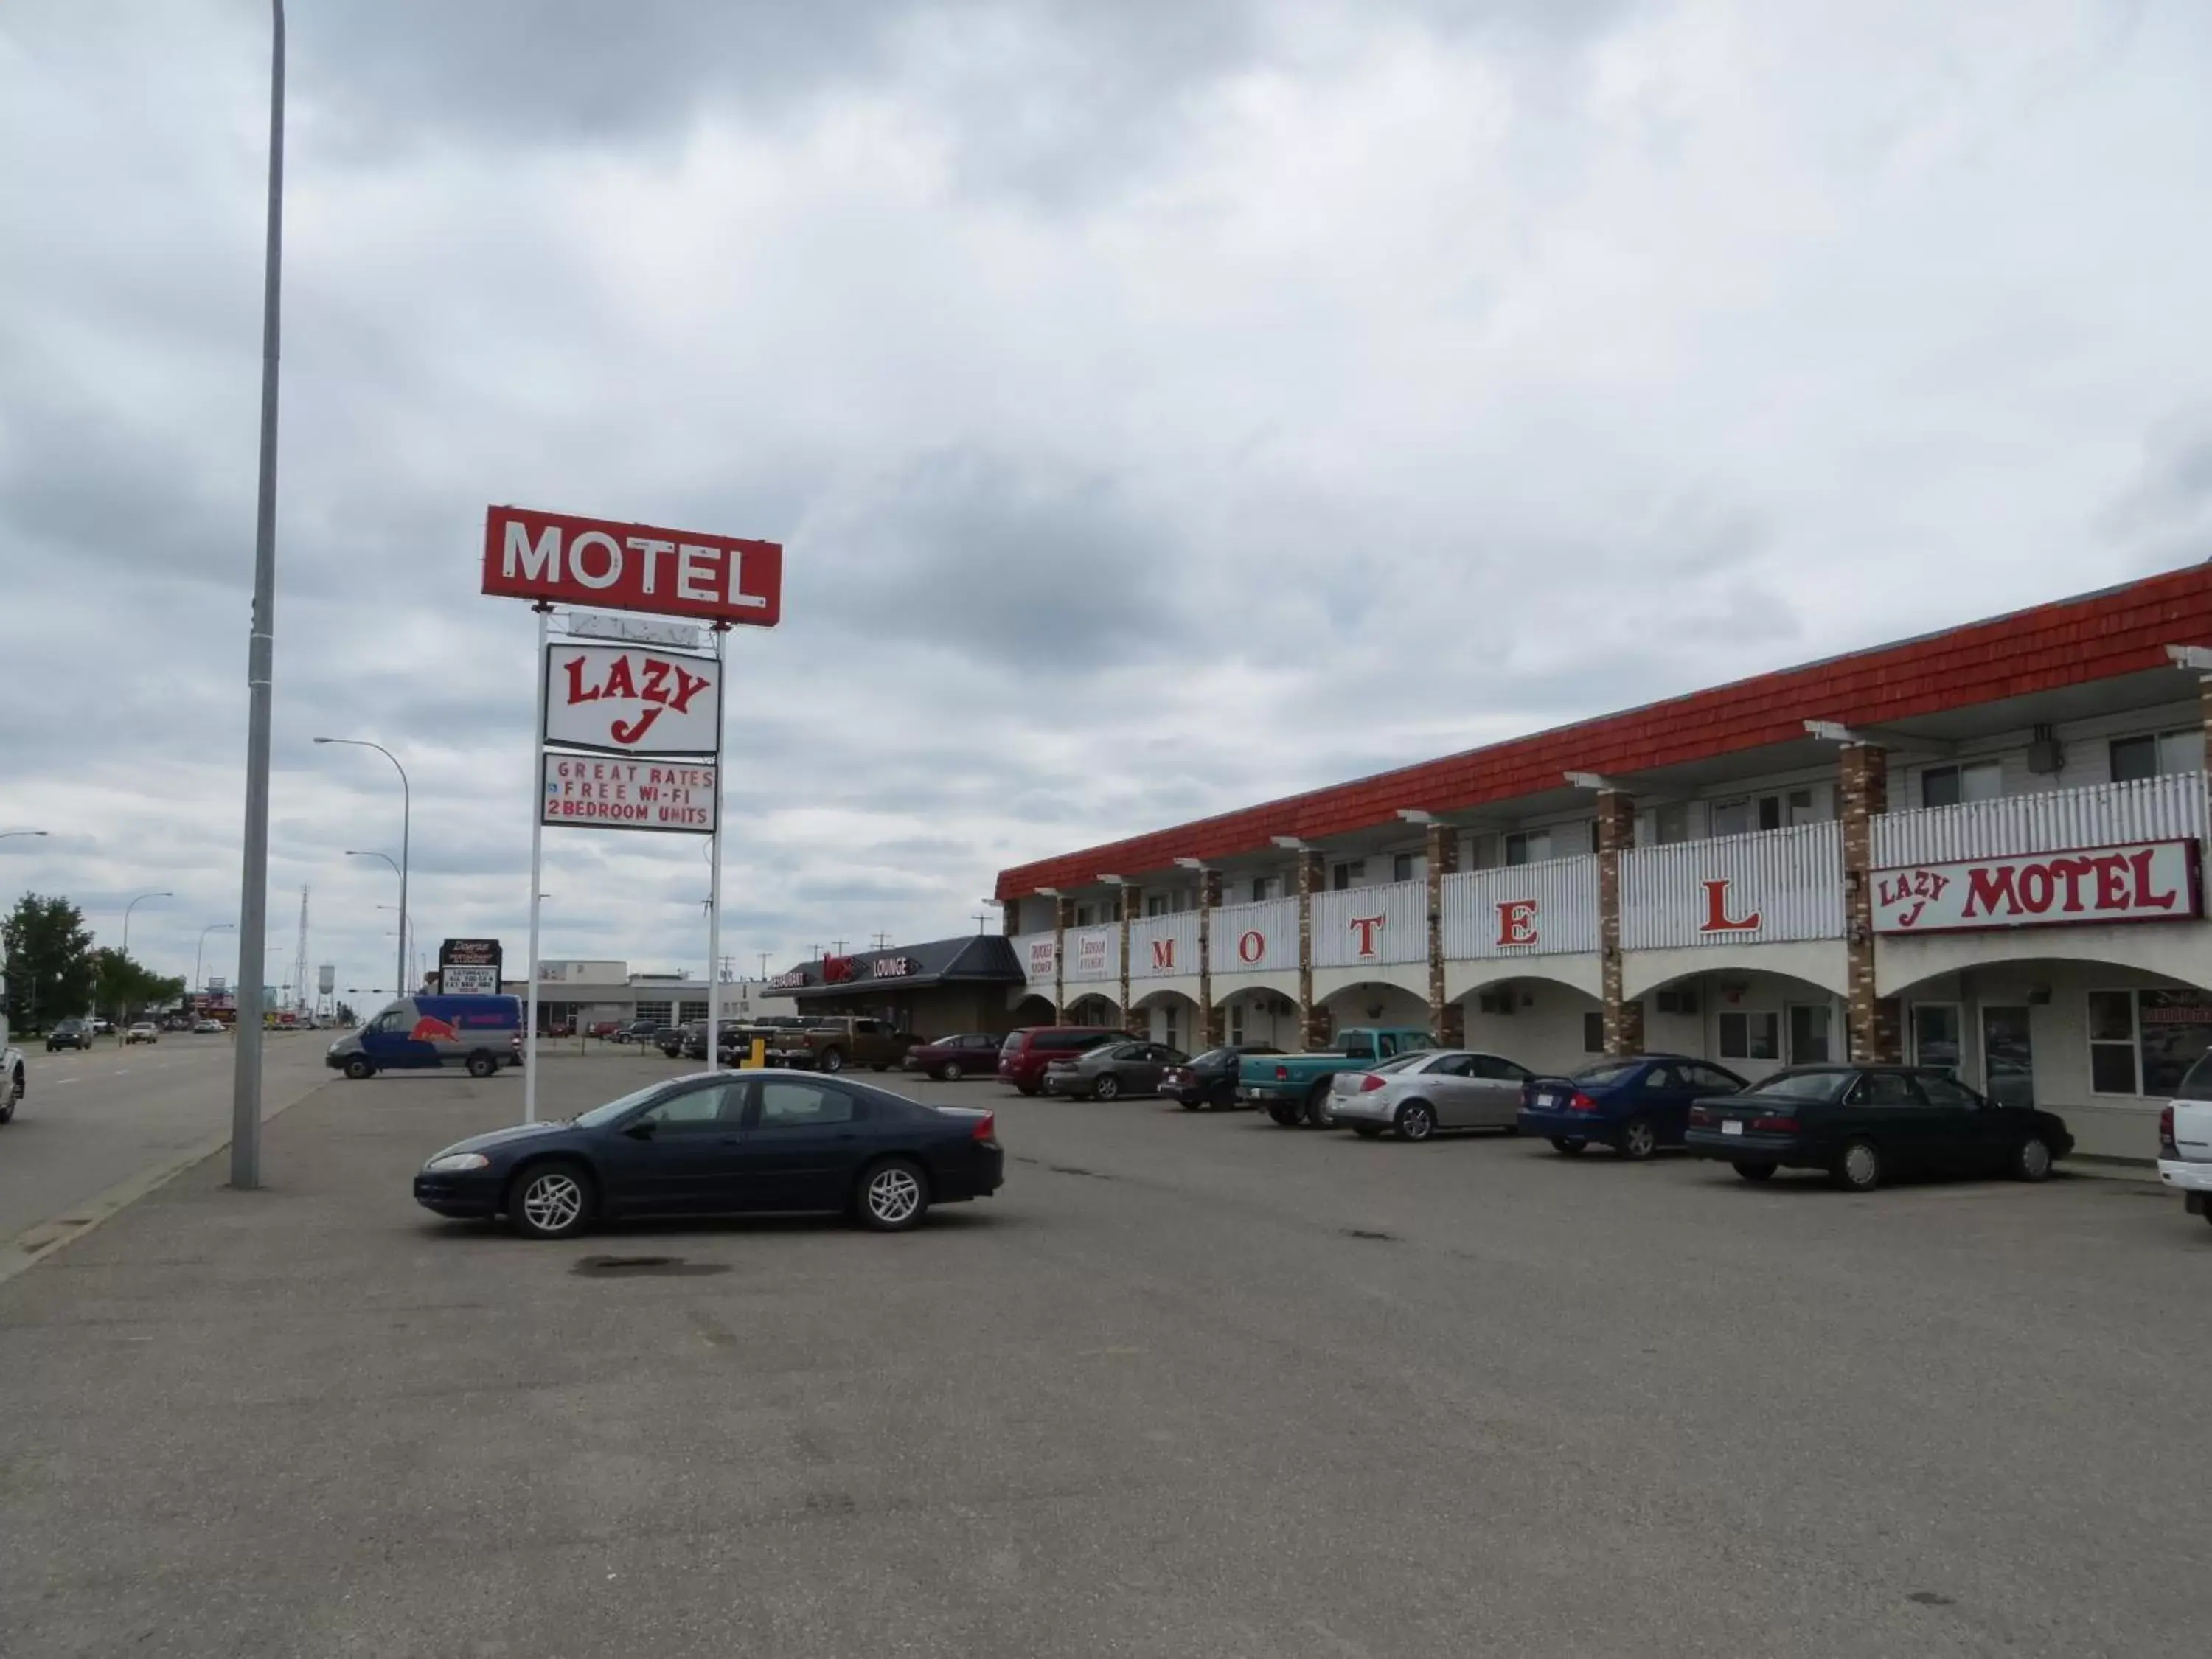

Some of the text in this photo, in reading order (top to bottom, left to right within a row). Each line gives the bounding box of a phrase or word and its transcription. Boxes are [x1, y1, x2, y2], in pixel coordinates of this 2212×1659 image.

[502, 521, 767, 608] MOTEL
[564, 655, 711, 714] LAZY
[611, 707, 664, 744] J
[558, 761, 713, 788] GREAT RATES
[565, 781, 690, 804] FREE WI-FI
[1877, 871, 1950, 908] LAZY
[1961, 849, 2177, 918] MOTEL
[1899, 901, 1927, 927] J
[873, 957, 907, 977] LOUNGE
